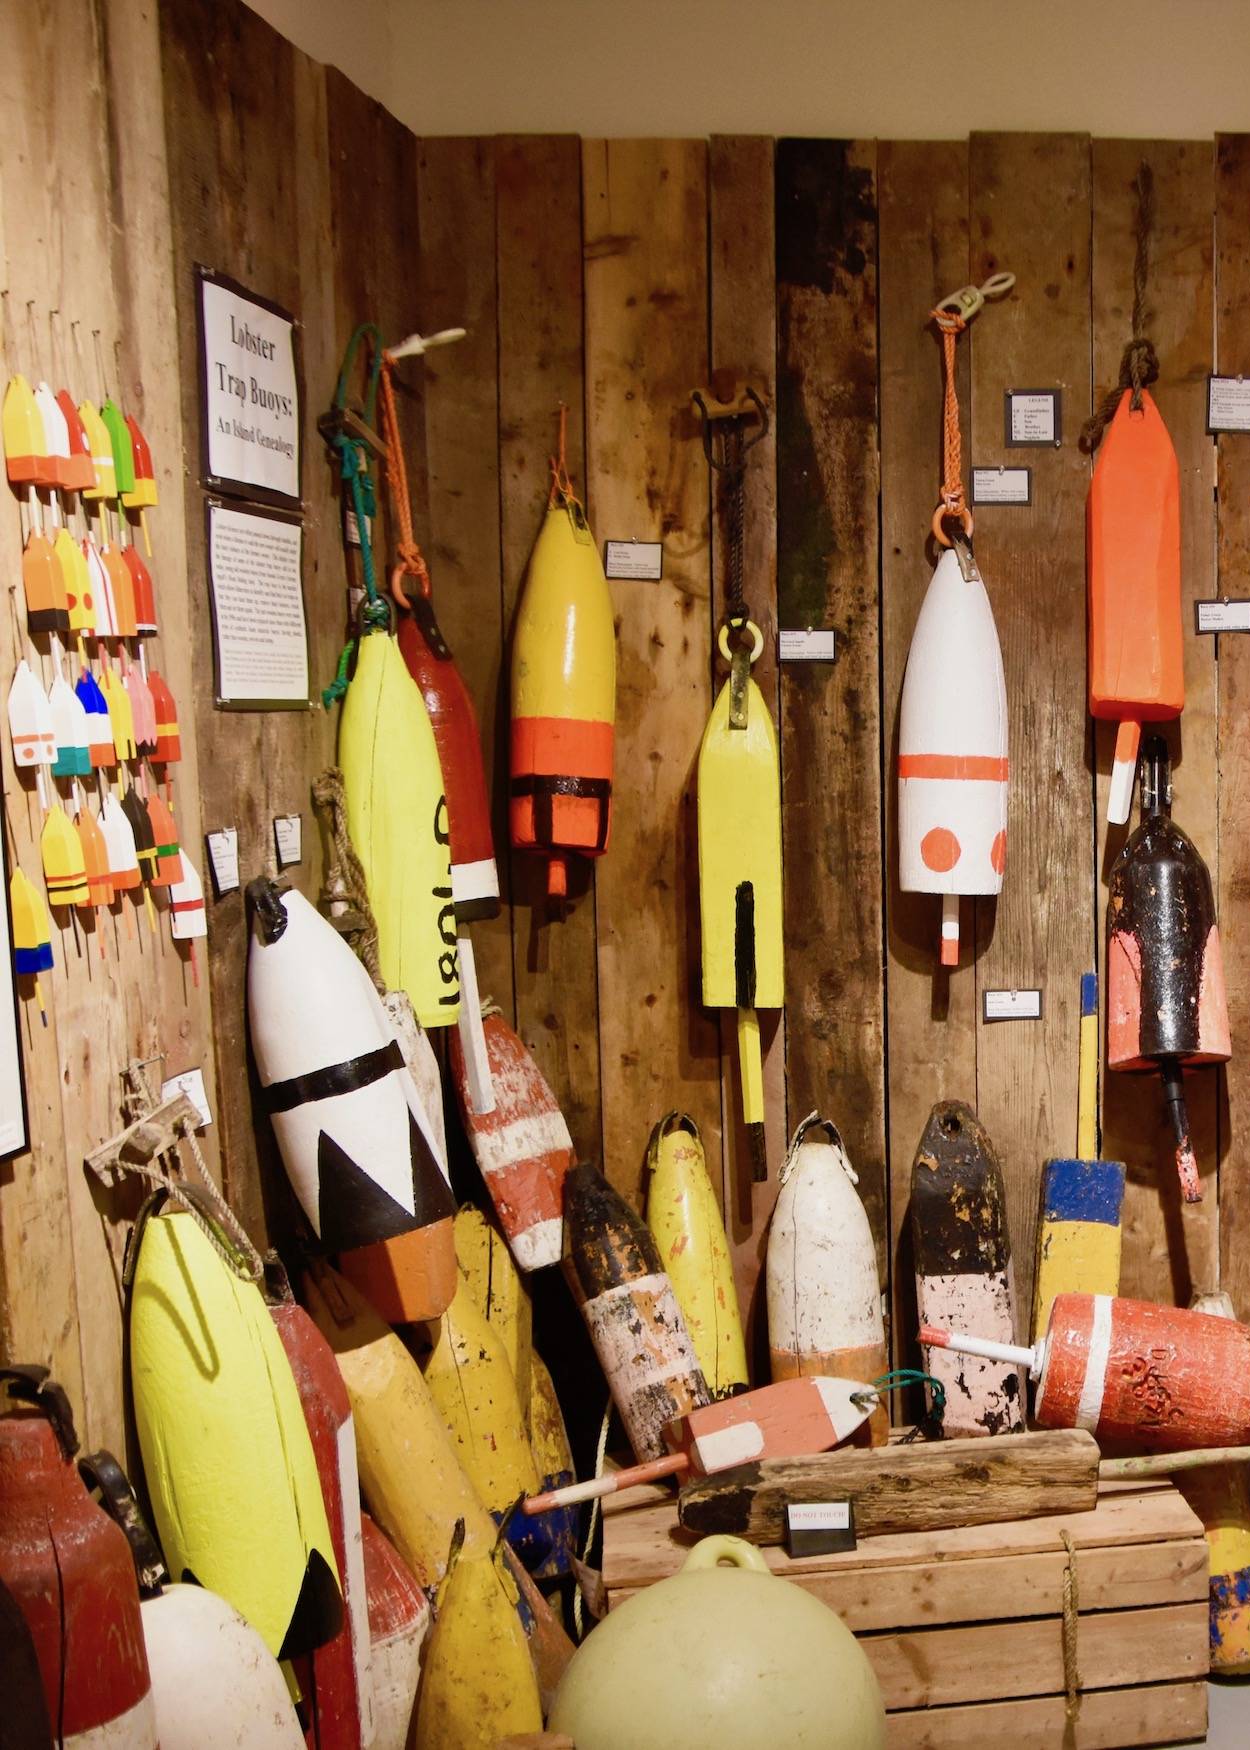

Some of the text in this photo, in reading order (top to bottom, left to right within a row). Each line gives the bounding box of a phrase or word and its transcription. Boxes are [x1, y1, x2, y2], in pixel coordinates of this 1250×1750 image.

[230, 314, 276, 361] Lobster
[215, 361, 292, 420] Trap Buoys:
[216, 416, 294, 460] An Island Genealogy
